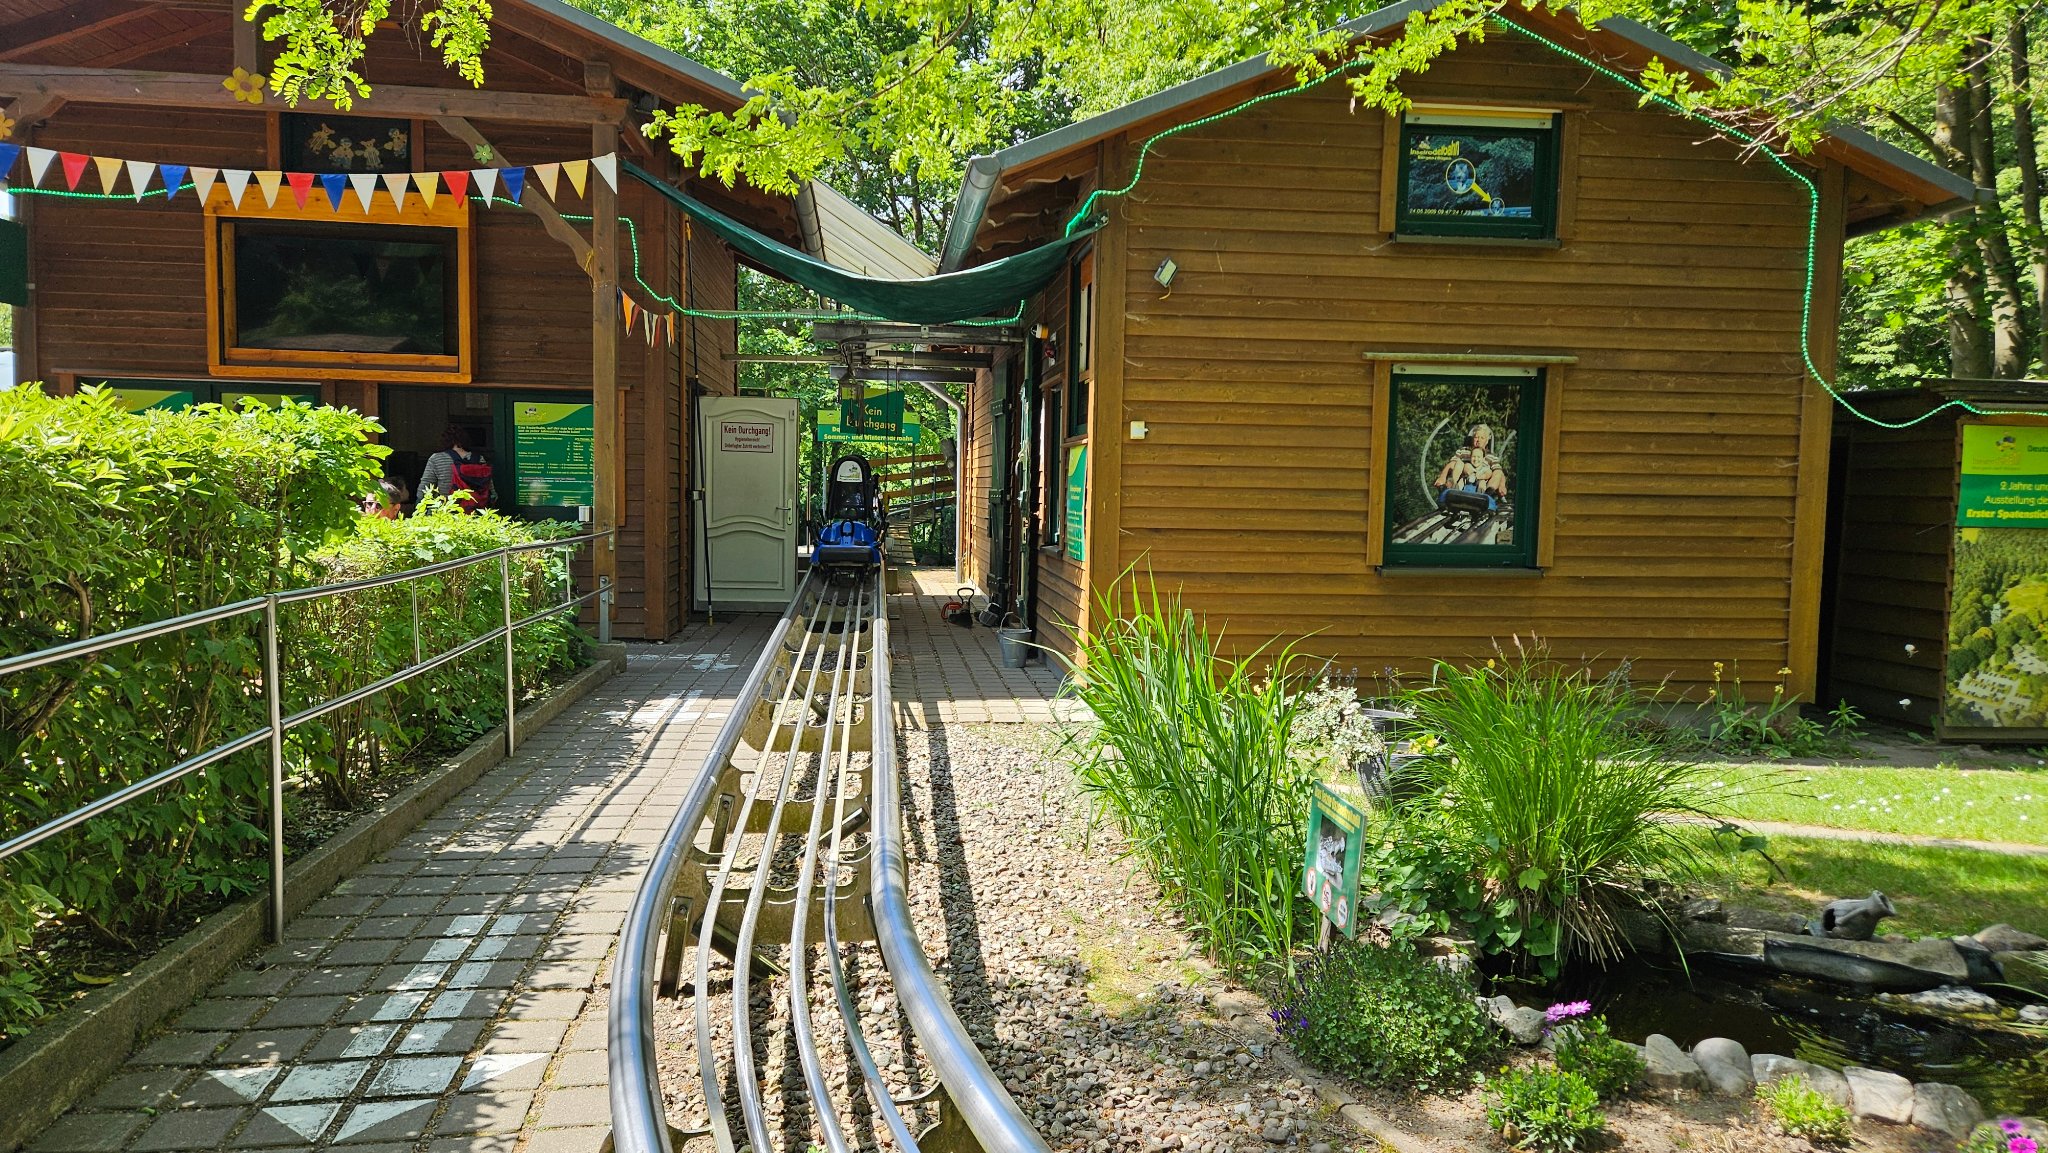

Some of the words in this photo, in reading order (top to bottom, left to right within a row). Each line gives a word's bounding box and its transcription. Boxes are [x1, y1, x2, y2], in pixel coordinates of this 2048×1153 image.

[847, 415, 896, 432] Duchgang
[724, 425, 737, 434] Kein
[738, 426, 771, 437] Durchgang!
[2008, 482, 2033, 490] Jahre
[1984, 496, 2035, 506] Ausstellung
[1967, 509, 1995, 518] Erster
